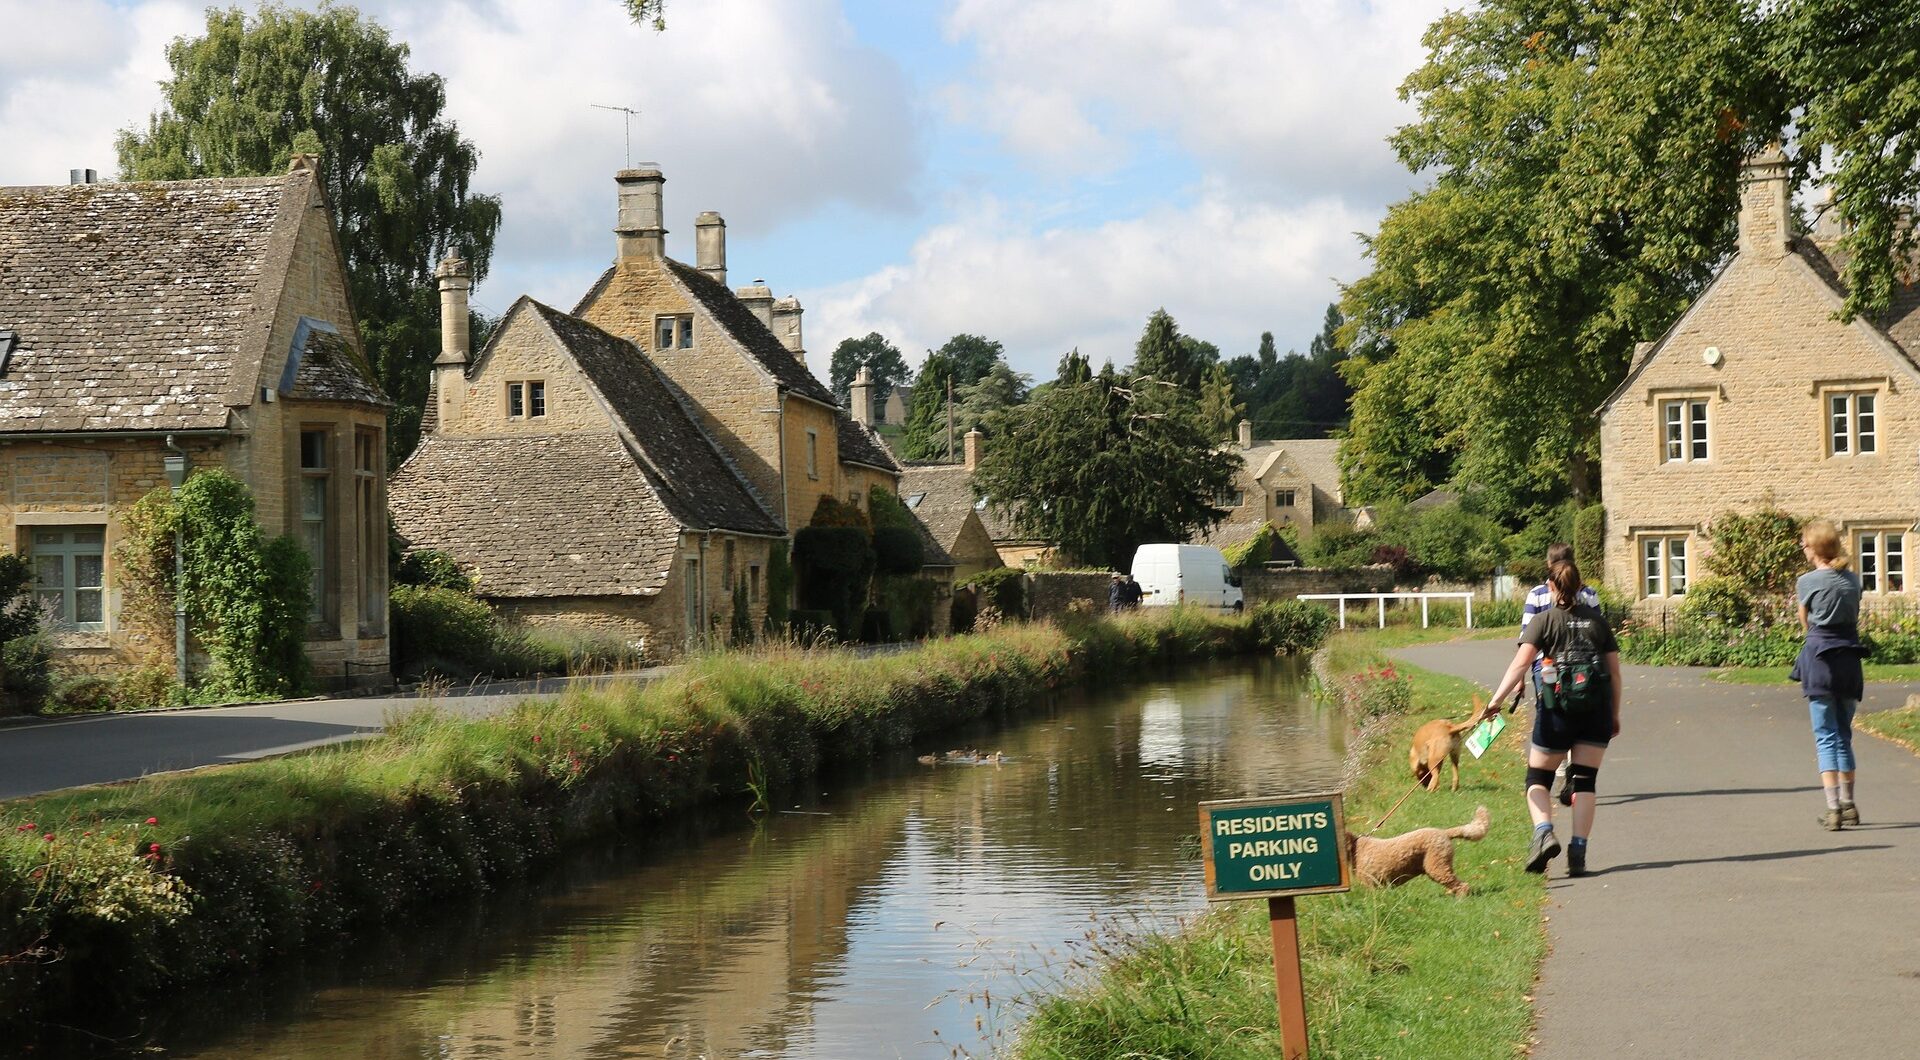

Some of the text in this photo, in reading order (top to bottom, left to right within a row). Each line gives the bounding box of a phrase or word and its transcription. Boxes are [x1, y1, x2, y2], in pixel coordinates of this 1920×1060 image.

[1216, 812, 1328, 836] RESIDENTS
[1229, 837, 1318, 859] PARKING
[1249, 862, 1302, 882] ONLY
